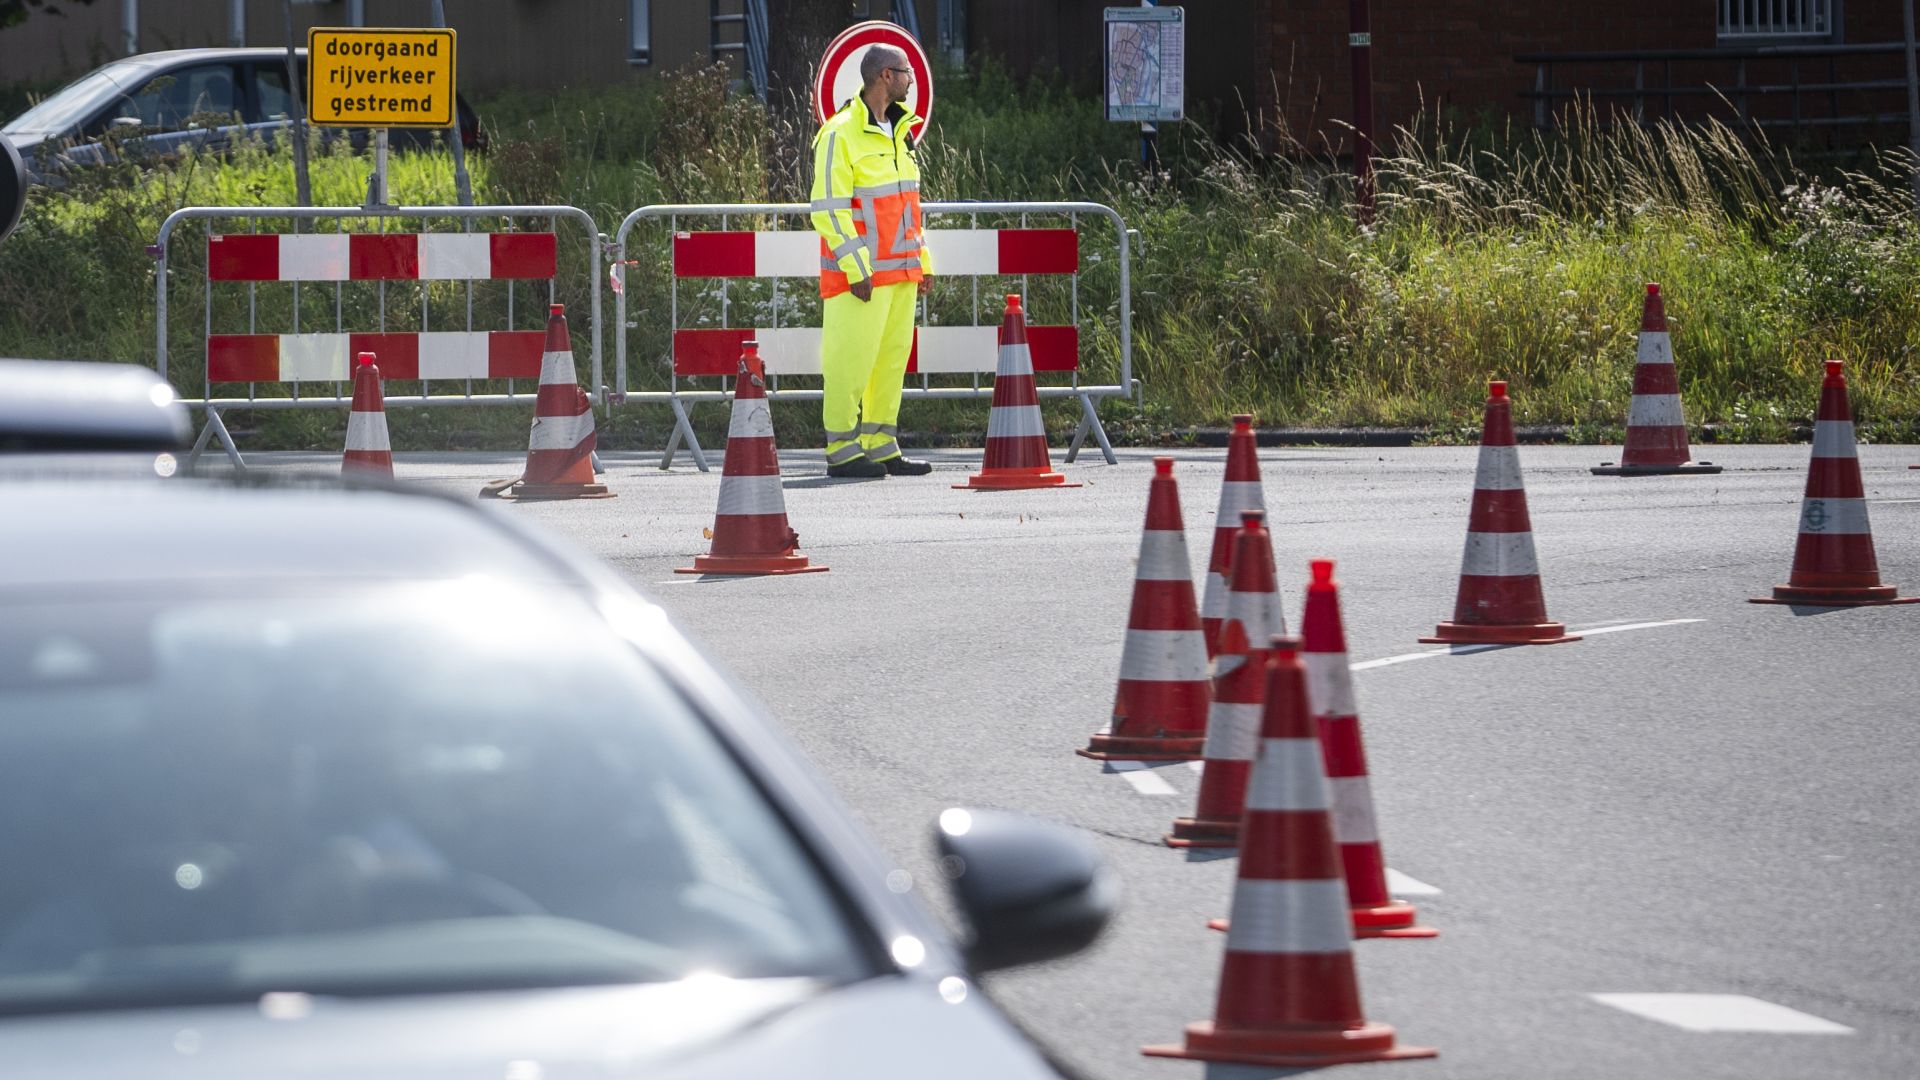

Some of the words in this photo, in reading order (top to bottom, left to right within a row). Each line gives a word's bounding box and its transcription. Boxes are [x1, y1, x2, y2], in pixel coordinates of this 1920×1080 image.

[326, 38, 438, 61] doorgaand
[330, 66, 436, 89] rijverkeer
[330, 94, 432, 116] gestremd
